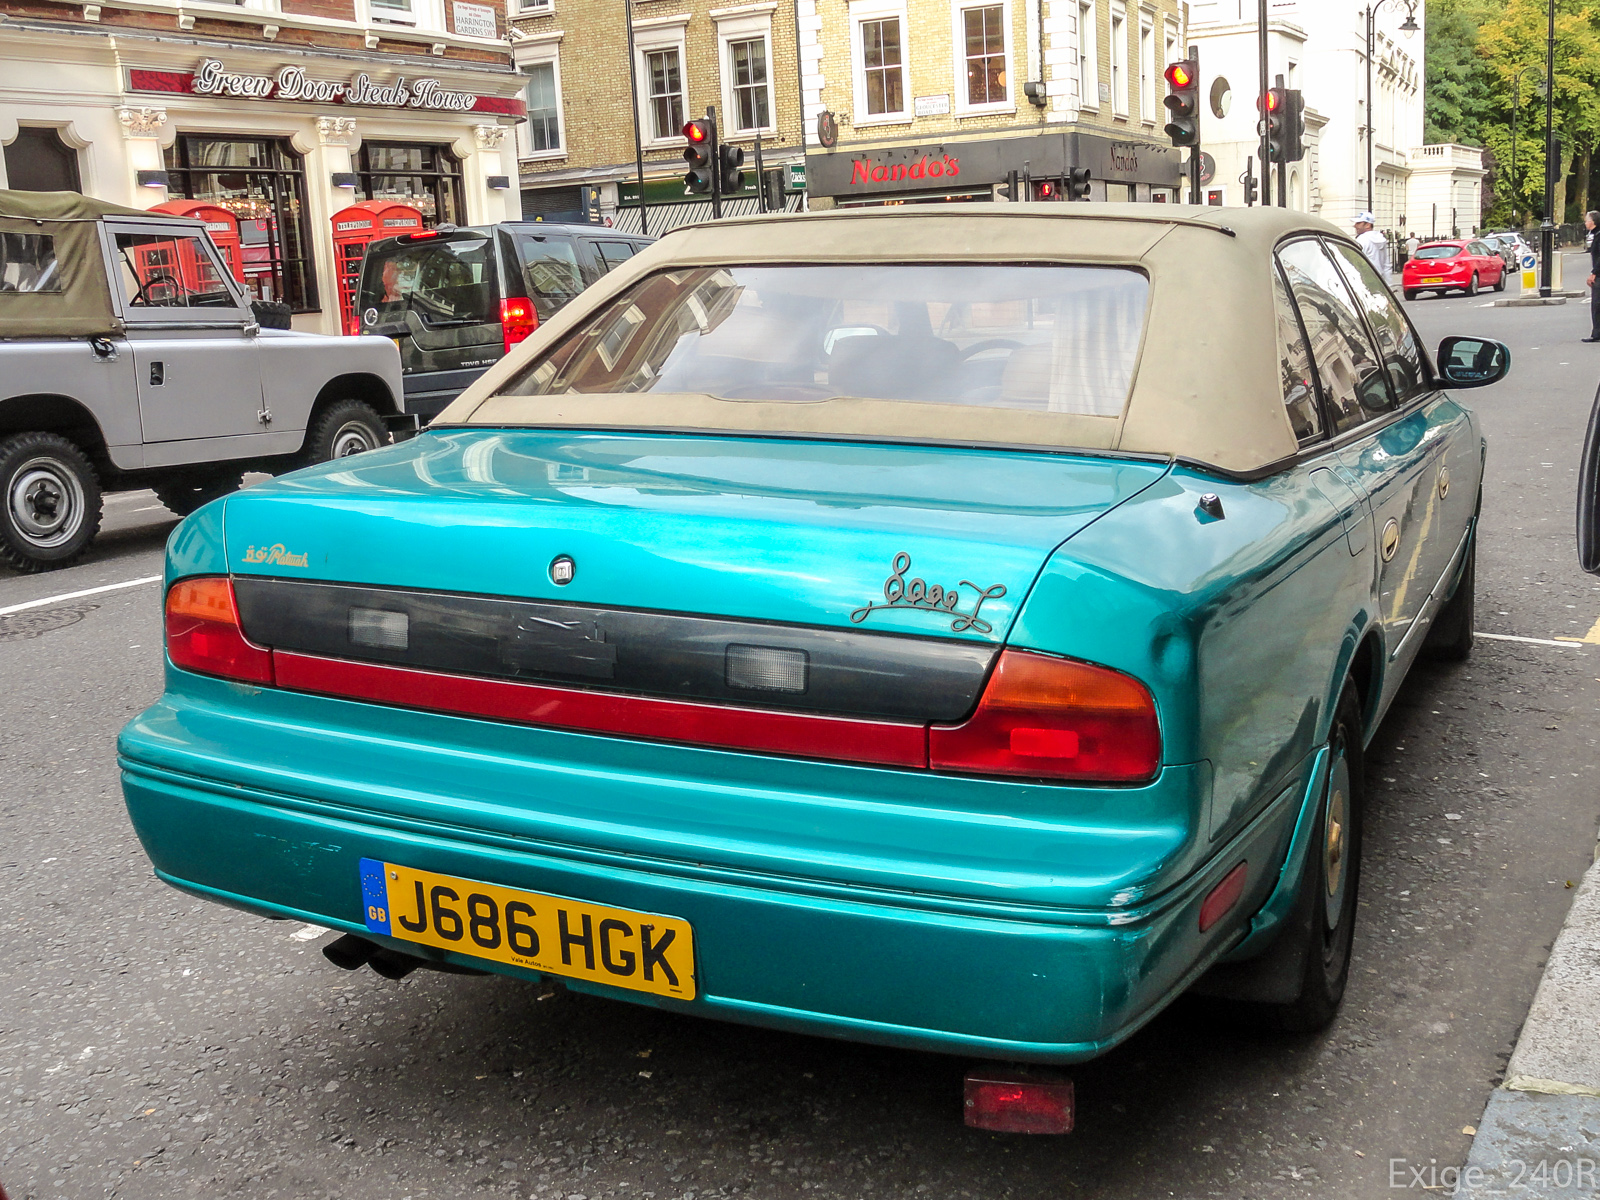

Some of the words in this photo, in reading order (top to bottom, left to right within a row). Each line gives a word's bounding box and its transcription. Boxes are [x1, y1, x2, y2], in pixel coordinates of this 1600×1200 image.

[456, 16, 494, 28] HARRINGTON
[456, 25, 483, 35] GARDENS
[484, 29, 495, 37] SW7
[199, 59, 274, 97] Green
[279, 66, 343, 101] Door
[346, 73, 410, 105] Steak
[410, 78, 478, 111] House
[850, 154, 960, 185] Nando's
[1110, 147, 1138, 172] Nando's
[368, 905, 387, 922] GB
[398, 880, 540, 958] J686
[557, 908, 680, 987] HGK
[525, 958, 542, 968] Autos
